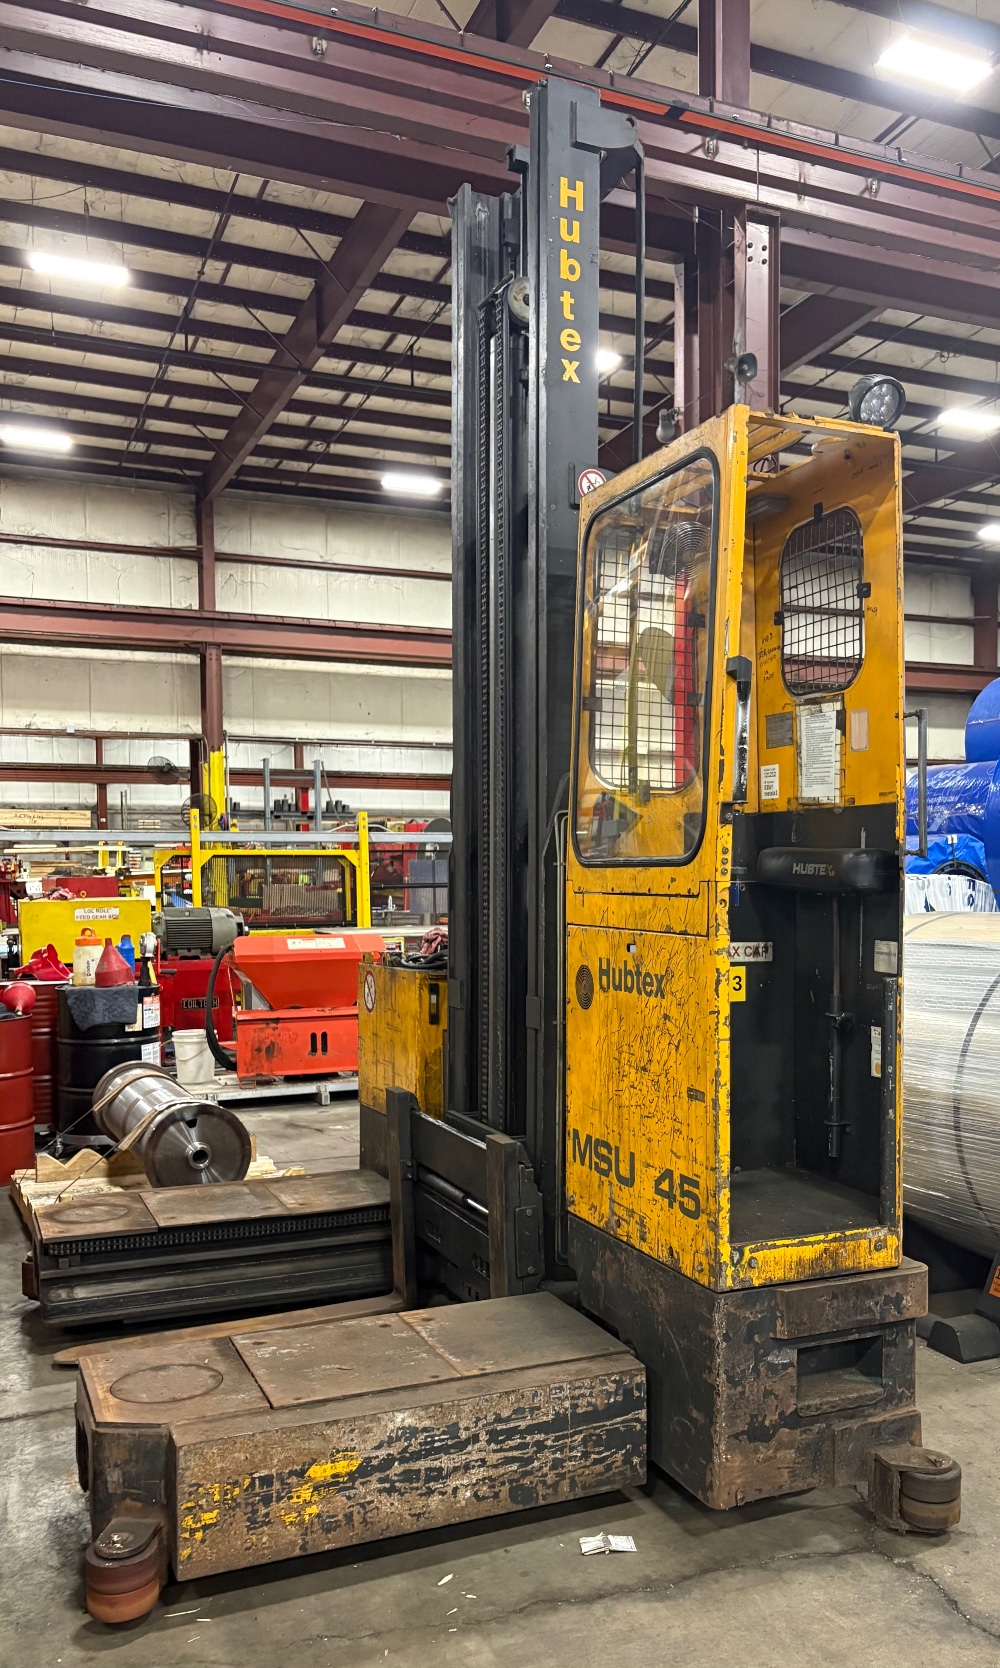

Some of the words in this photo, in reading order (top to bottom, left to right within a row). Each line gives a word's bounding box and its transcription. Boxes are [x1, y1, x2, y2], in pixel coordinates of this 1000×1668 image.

[559, 176, 584, 384] Hubtex
[182, 999, 218, 1009] COILTEH
[598, 956, 666, 999] Hubtex
[572, 1127, 636, 1188] MSU
[653, 1167, 701, 1221] 45
